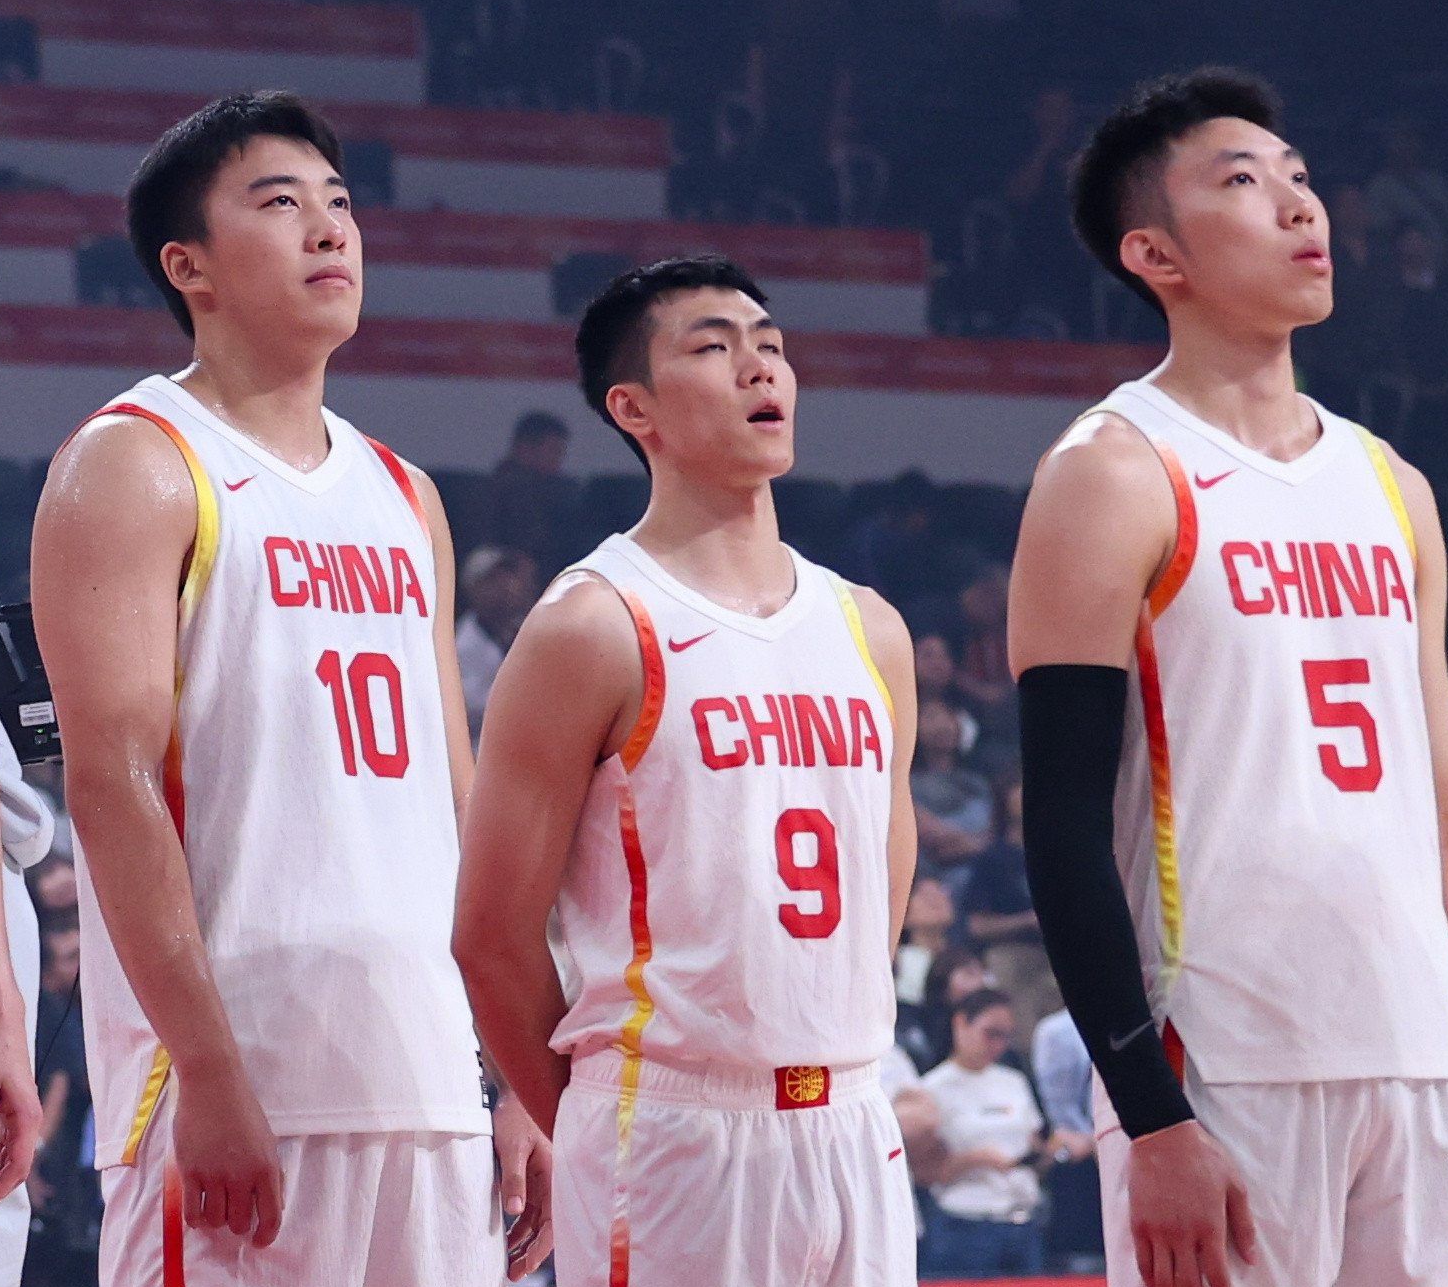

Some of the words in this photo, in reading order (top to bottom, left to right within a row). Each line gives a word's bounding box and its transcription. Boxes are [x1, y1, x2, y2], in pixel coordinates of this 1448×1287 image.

[263, 536, 428, 617] CHINA
[1220, 541, 1414, 623] CHINA
[315, 649, 410, 779] 10
[691, 694, 884, 772] CHINA
[1301, 659, 1384, 792] 5
[775, 808, 842, 939] 9
